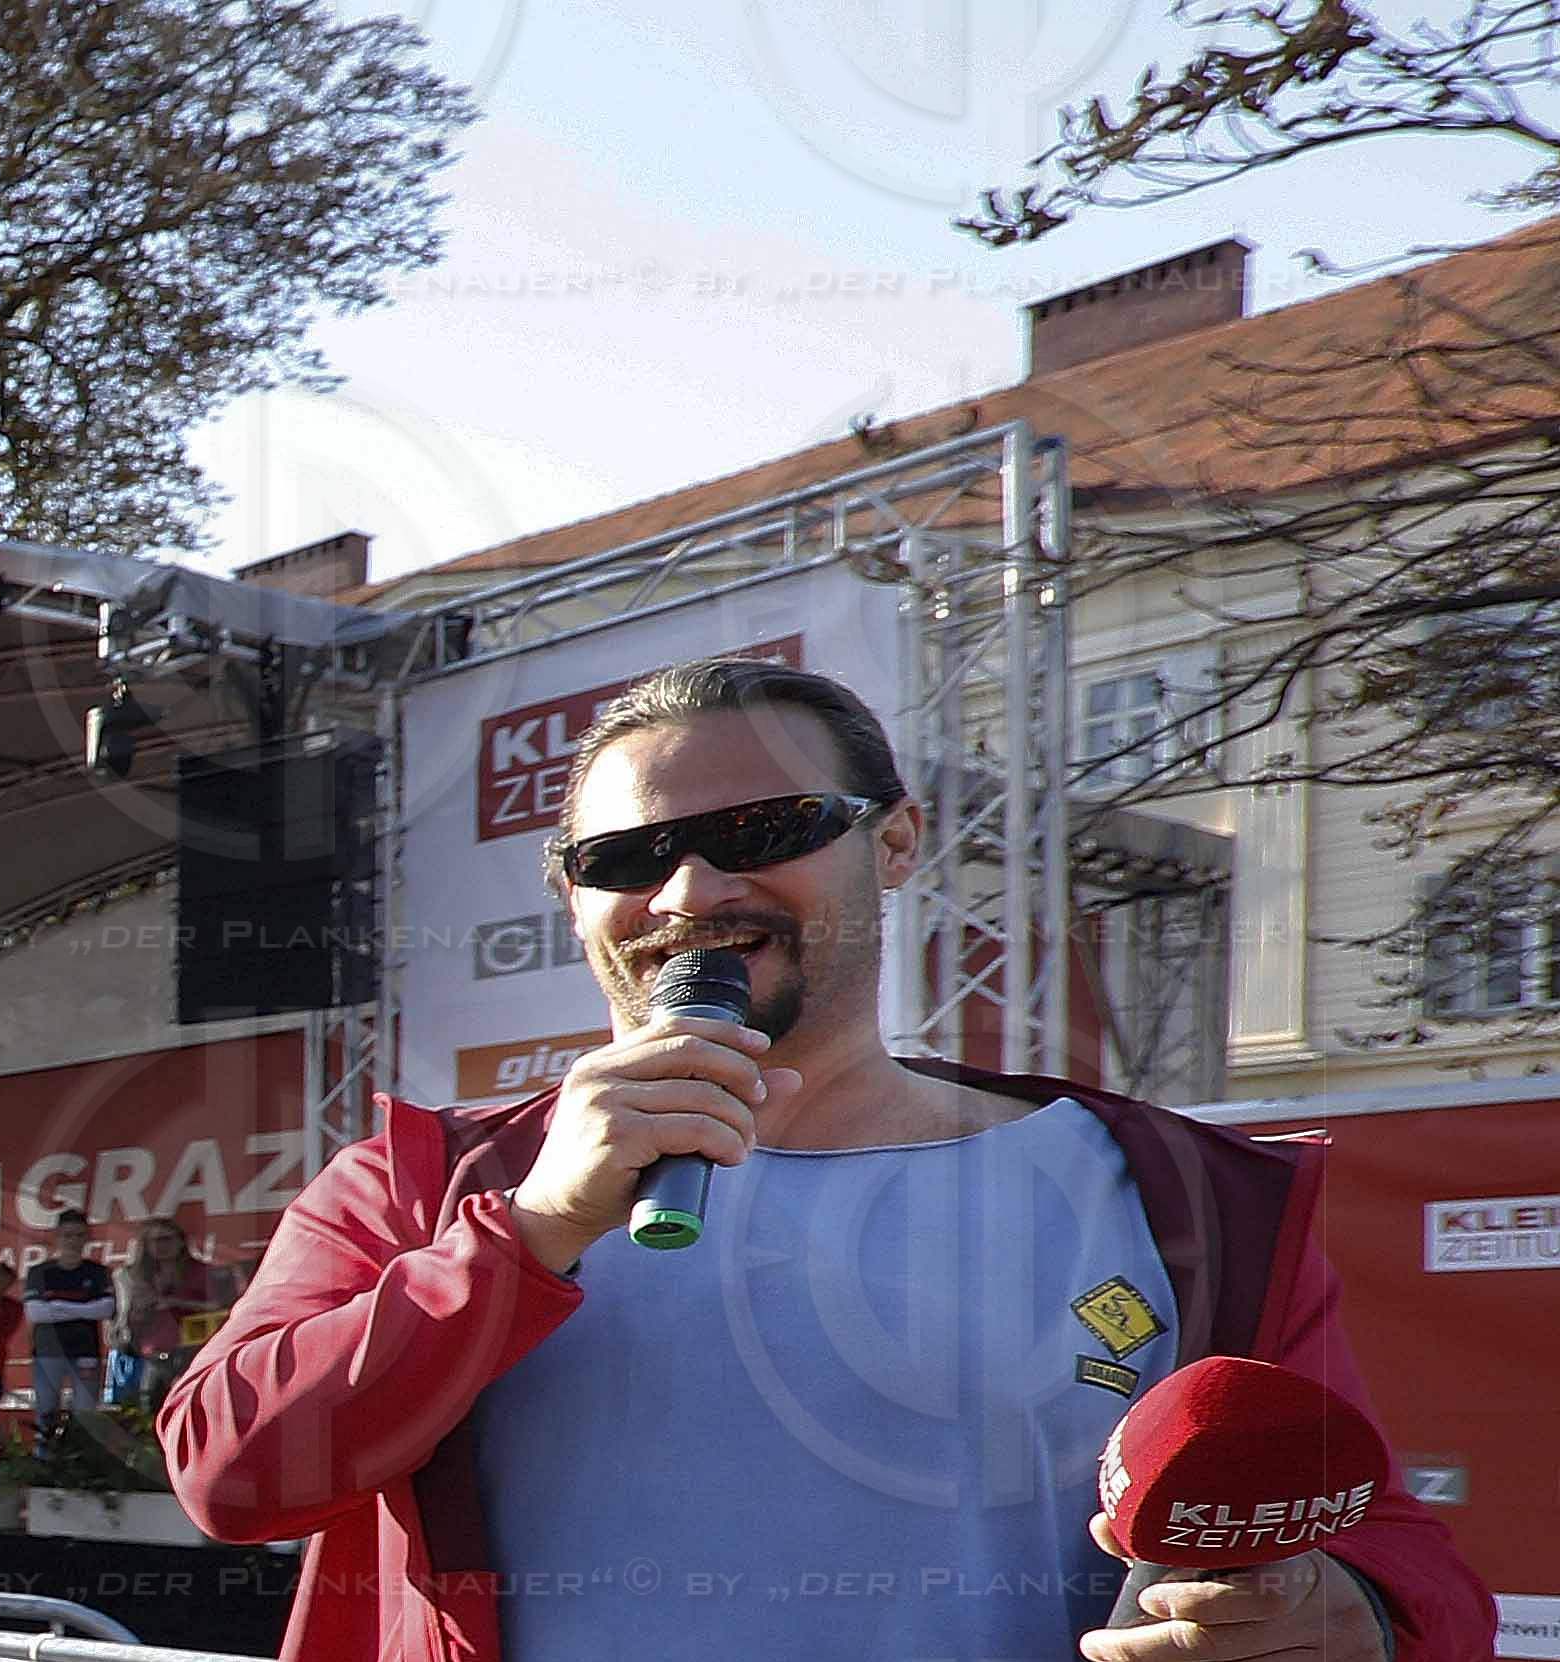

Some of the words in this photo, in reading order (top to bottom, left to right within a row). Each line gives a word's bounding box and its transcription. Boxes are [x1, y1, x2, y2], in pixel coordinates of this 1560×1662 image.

[16, 1130, 305, 1230] GRAZ
[1439, 1206, 1560, 1233] KLEI
[1437, 1232, 1560, 1262] ZEITU
[1168, 1480, 1375, 1526] KLEINE
[1160, 1506, 1366, 1548] ZEITUNG
